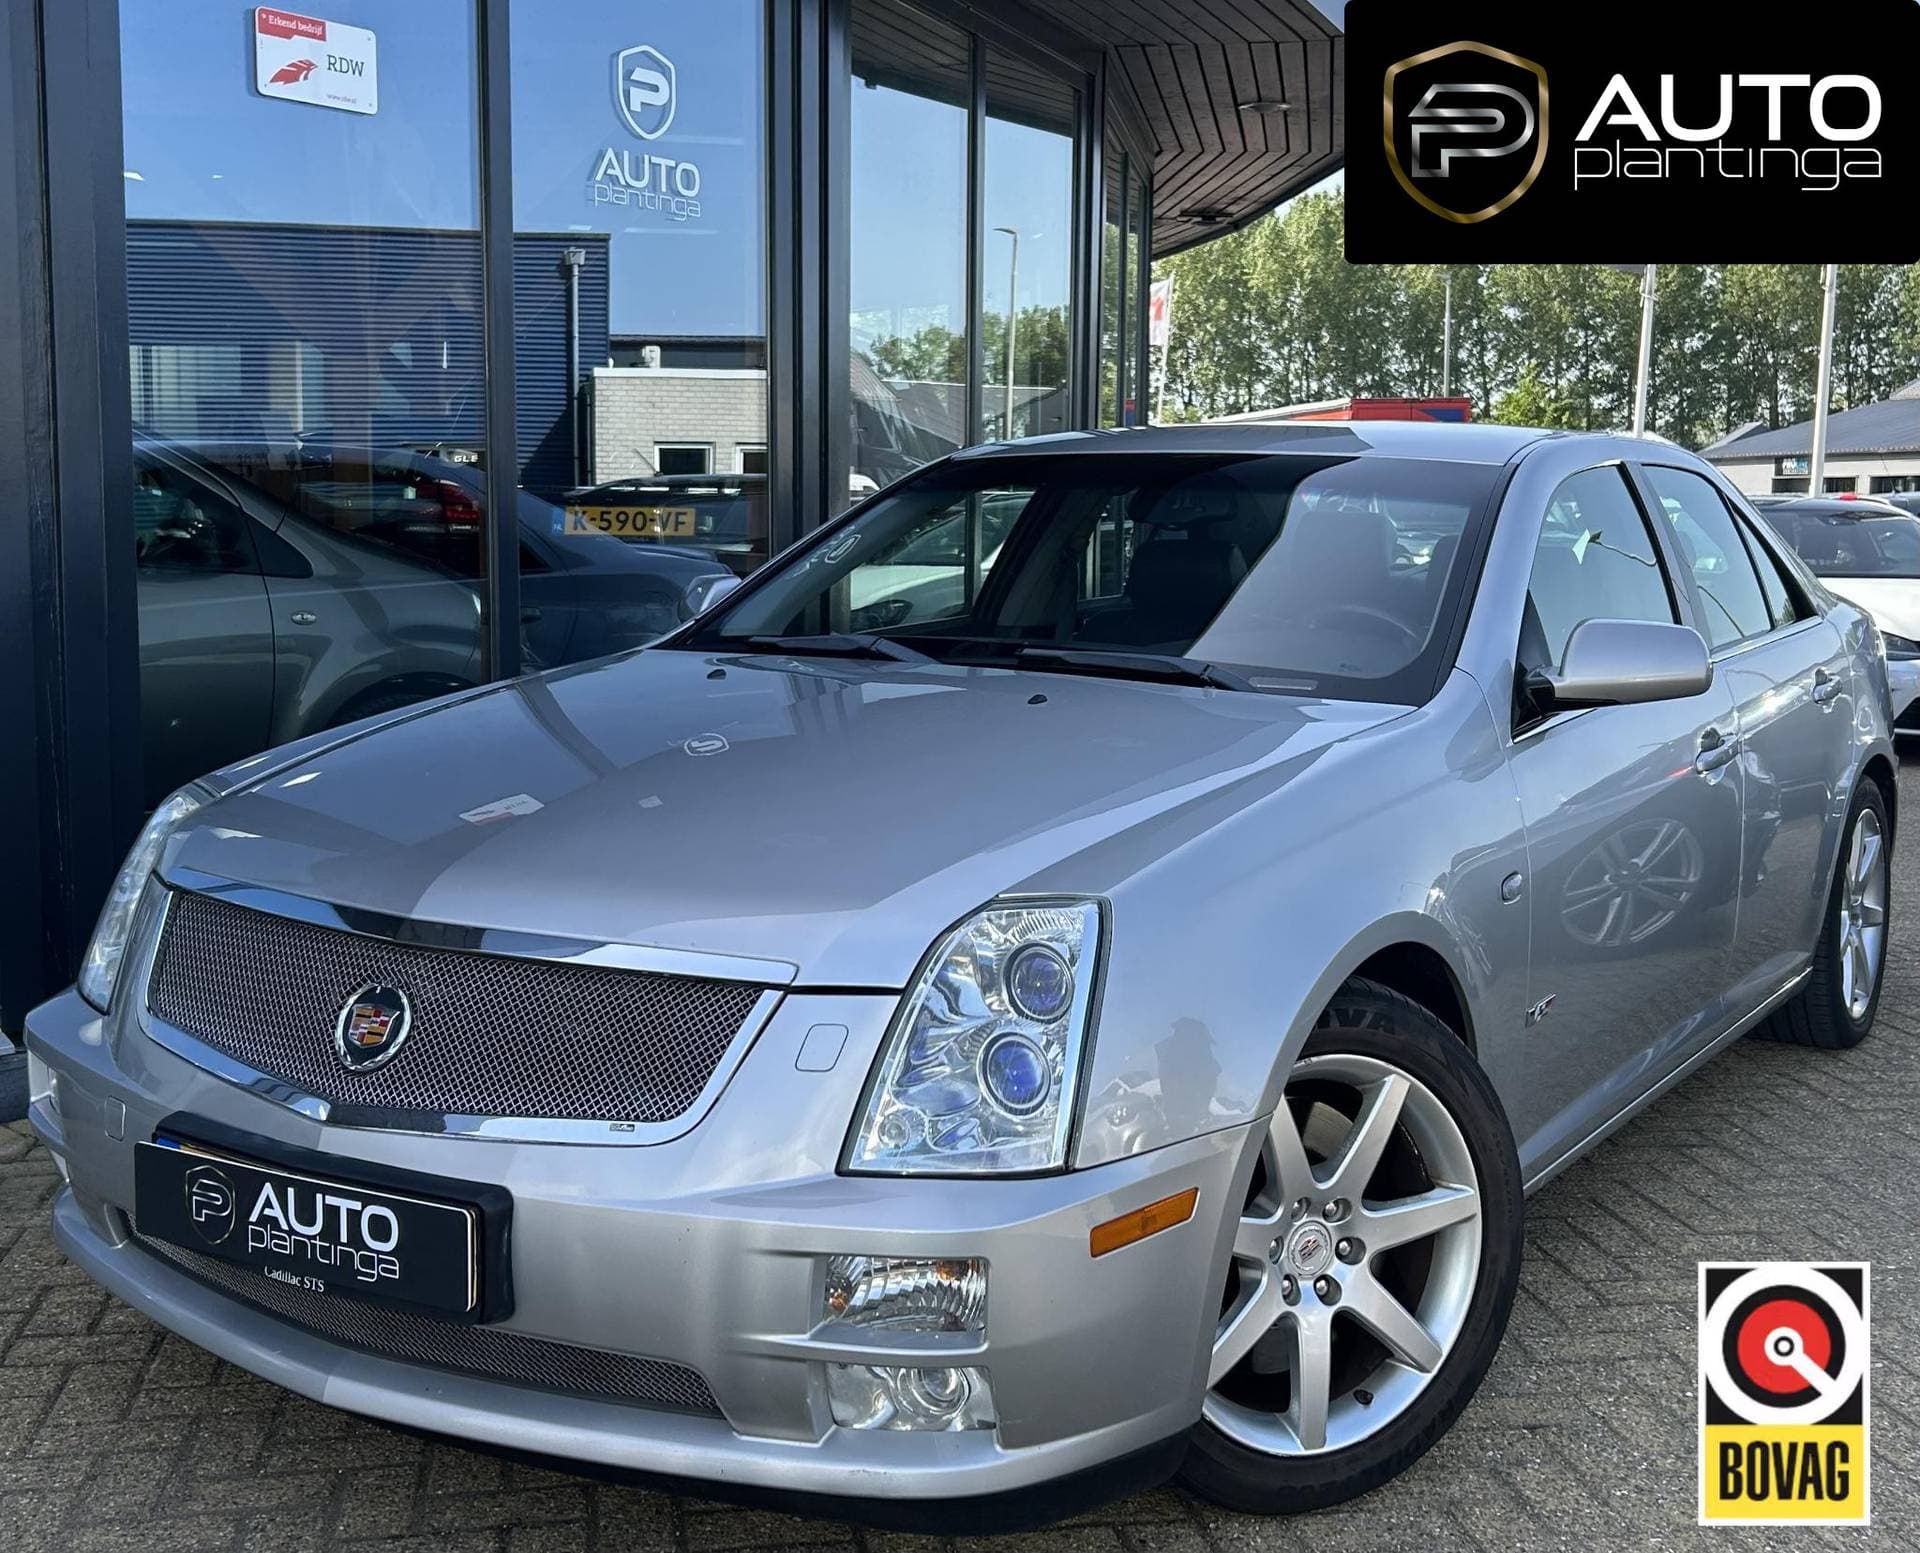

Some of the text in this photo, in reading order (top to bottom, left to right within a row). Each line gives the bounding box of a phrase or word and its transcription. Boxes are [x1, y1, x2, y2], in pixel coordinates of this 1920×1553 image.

[268, 14, 323, 36] Erkend bedrijf
[327, 54, 365, 77] RDW
[595, 147, 700, 198] AUTO
[594, 182, 701, 222] plantinga
[572, 509, 688, 533] K-590-VF
[249, 1182, 400, 1252] AUTO
[248, 1223, 400, 1282] plantinga
[264, 1265, 325, 1293] Cadillac STS
